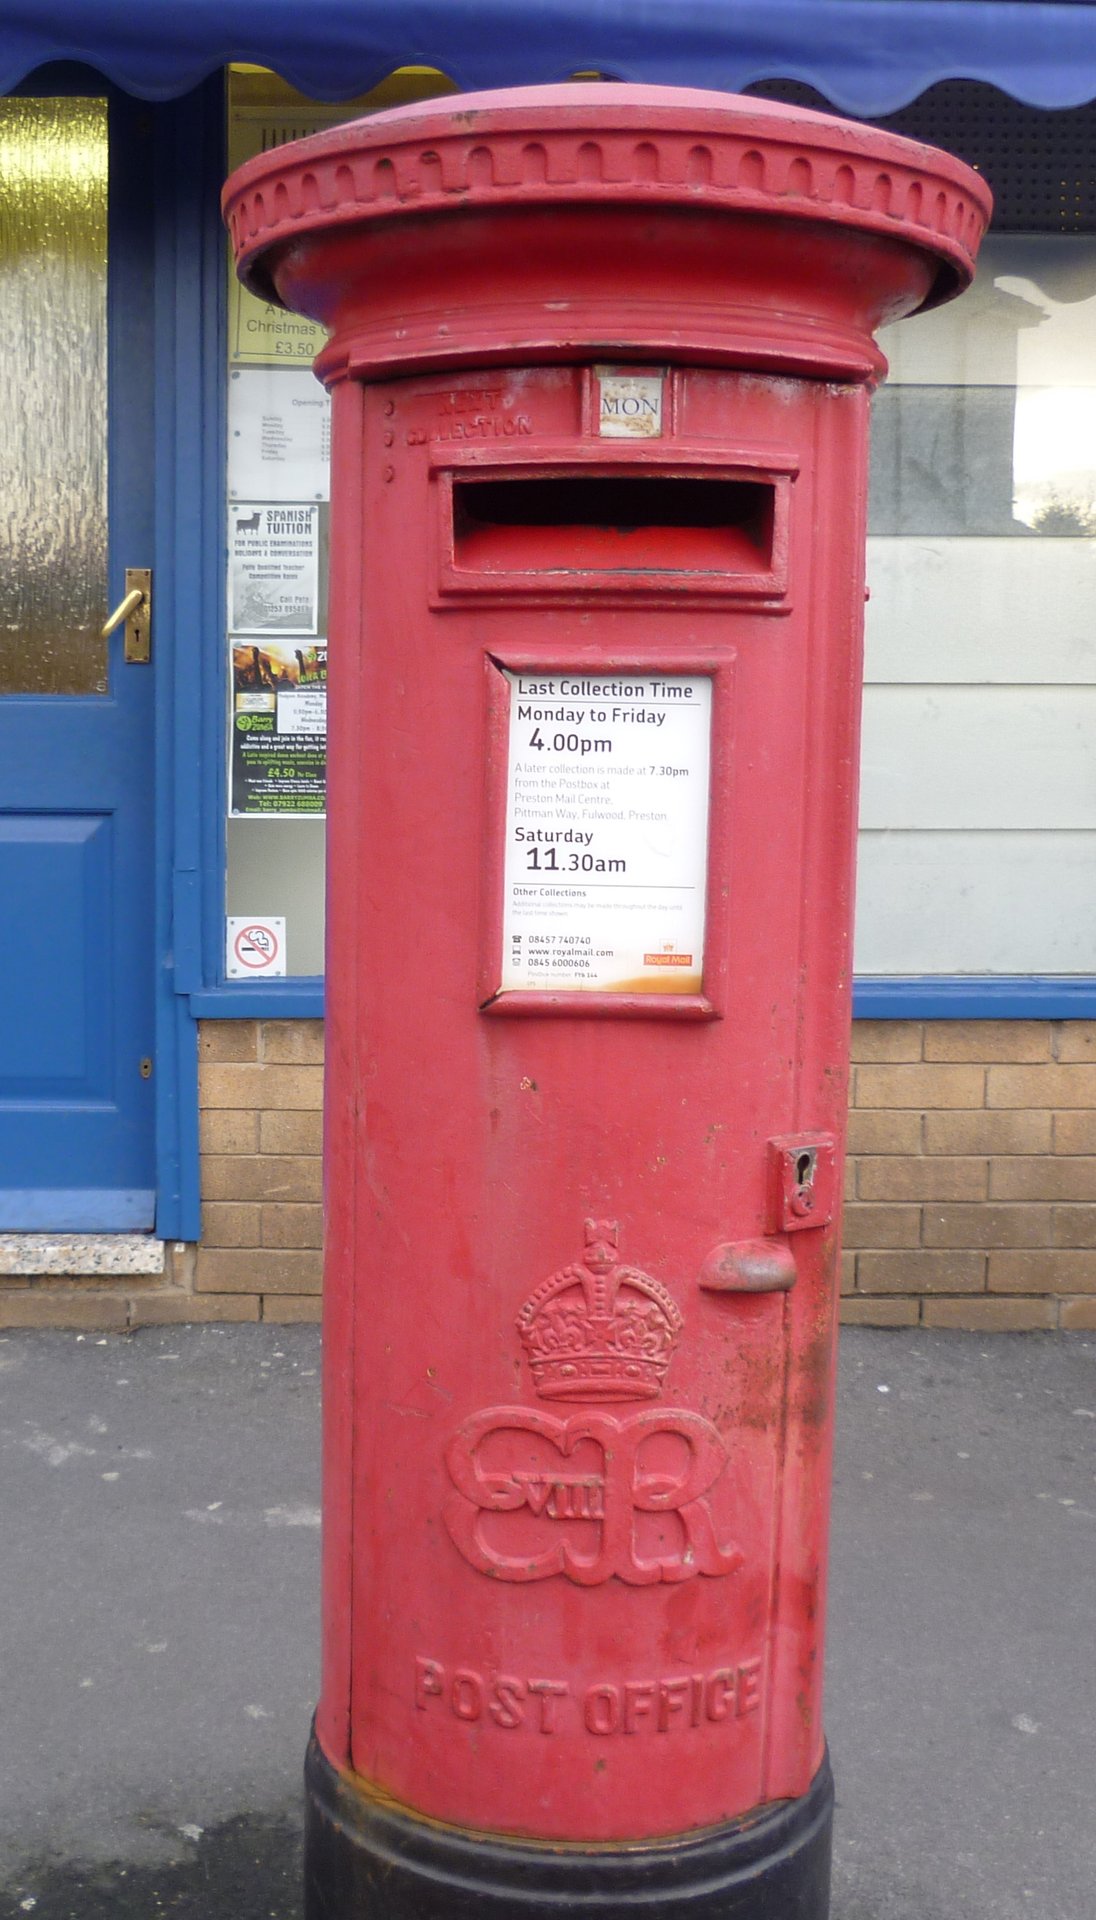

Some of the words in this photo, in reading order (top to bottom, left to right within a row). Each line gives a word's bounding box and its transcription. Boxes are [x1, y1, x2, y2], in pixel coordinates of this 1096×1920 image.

[246, 320, 316, 336] Christmas
[276, 341, 314, 356] £3.50
[600, 398, 658, 416] MON
[266, 510, 312, 522] SPANISH
[266, 523, 312, 534] TUITION
[518, 680, 556, 695] Last
[560, 680, 644, 698] Collection
[650, 682, 694, 698] Time
[518, 706, 584, 724] Monday
[590, 709, 606, 722] to
[612, 708, 666, 726] Friday
[528, 728, 612, 756] 4.00pm
[268, 768, 295, 778] £4.50
[514, 762, 522, 772] A
[524, 763, 546, 773] later
[548, 764, 595, 774] collection
[597, 766, 605, 774] is
[607, 765, 634, 775] made
[636, 766, 646, 776] at
[649, 766, 689, 778] 7.30pm
[514, 778, 538, 788] from
[541, 778, 557, 788] the
[560, 778, 598, 789] Postbox
[600, 780, 610, 790] at
[514, 792, 553, 803] Preston
[556, 794, 576, 804] Mail
[514, 807, 554, 818] Pittman
[628, 810, 667, 820] Preston
[514, 827, 594, 846] Saturday
[526, 847, 626, 872] 11.30am
[513, 888, 538, 896] Other
[540, 888, 587, 898] Collections
[528, 935, 556, 944] 08457
[558, 936, 591, 944] 740740
[528, 948, 614, 957] www.royalmail.com
[528, 958, 550, 967] 0845
[552, 959, 590, 968] 6000606
[646, 956, 670, 964] Royal
[672, 956, 690, 965] Mail
[414, 1656, 569, 1735] POST
[584, 1656, 762, 1735] OFFICE
